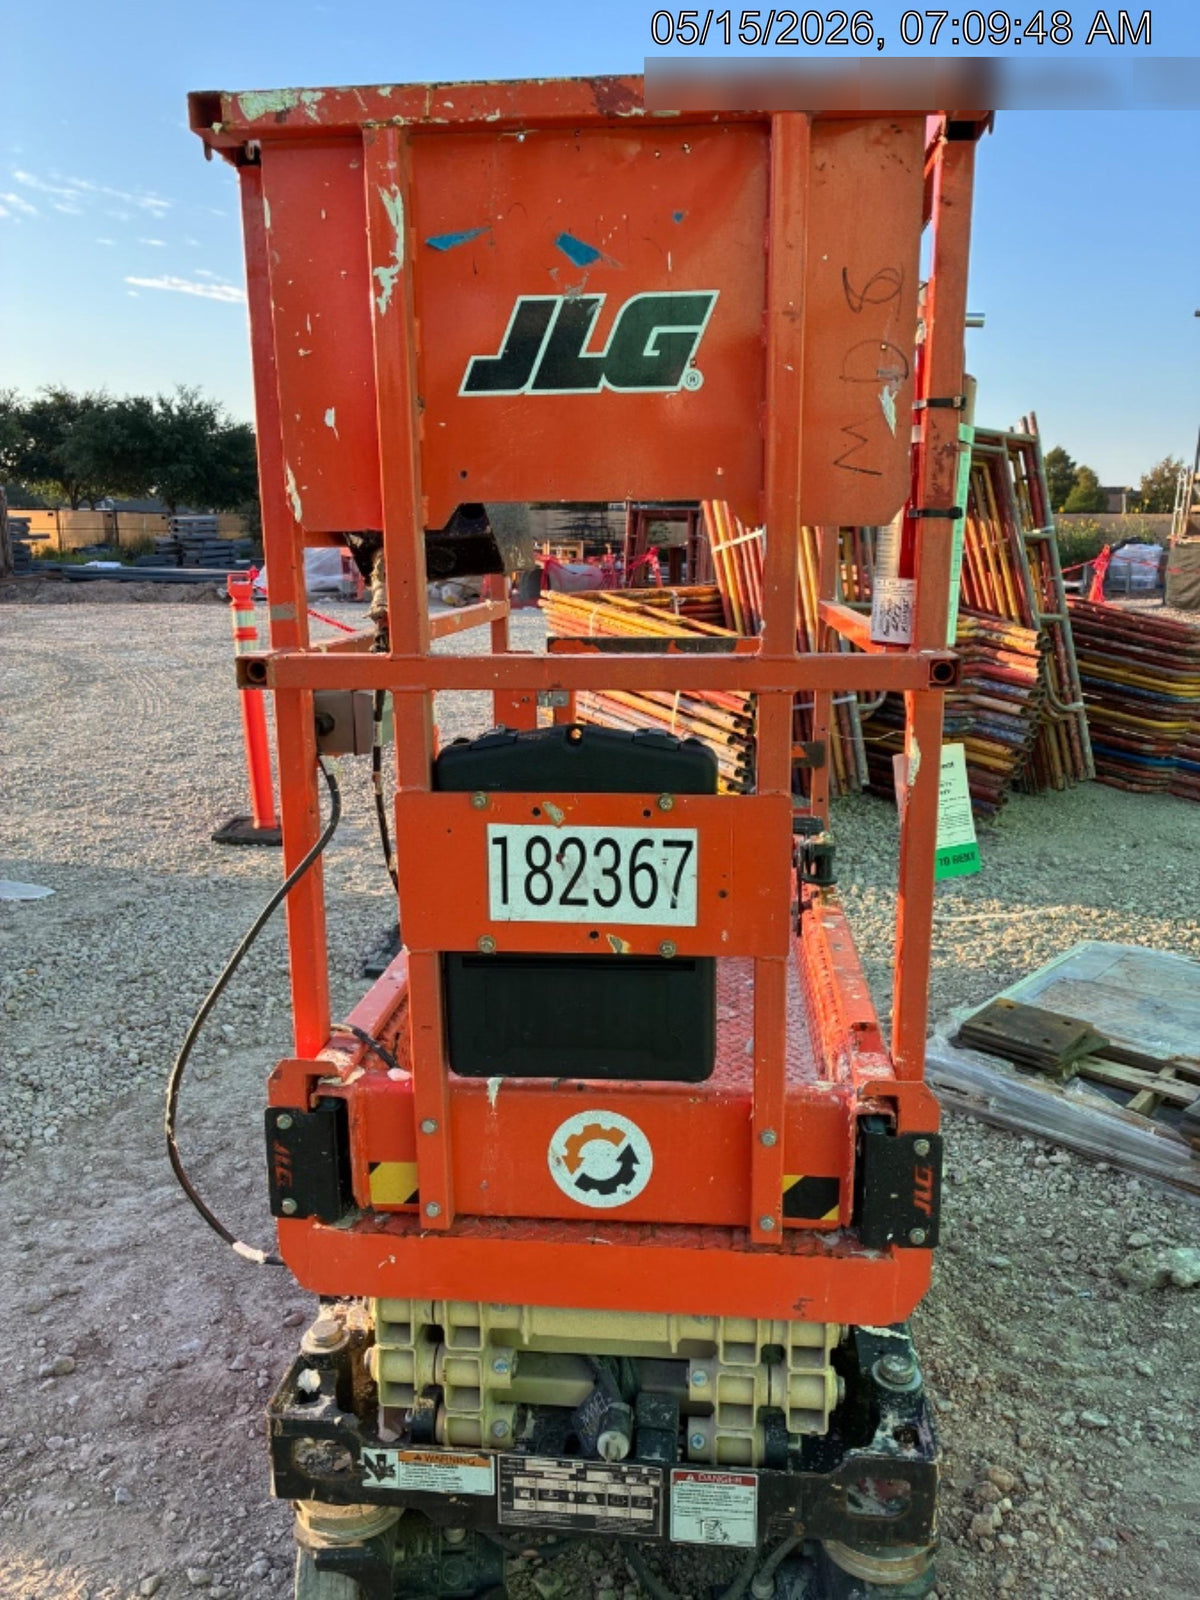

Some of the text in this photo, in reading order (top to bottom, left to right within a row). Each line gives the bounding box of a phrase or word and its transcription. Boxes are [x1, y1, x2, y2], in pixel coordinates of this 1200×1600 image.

[491, 835, 694, 910] 182367
[912, 1164, 935, 1218] JLG
[424, 1454, 475, 1466] WARNING
[698, 1473, 743, 1485] DANGER
